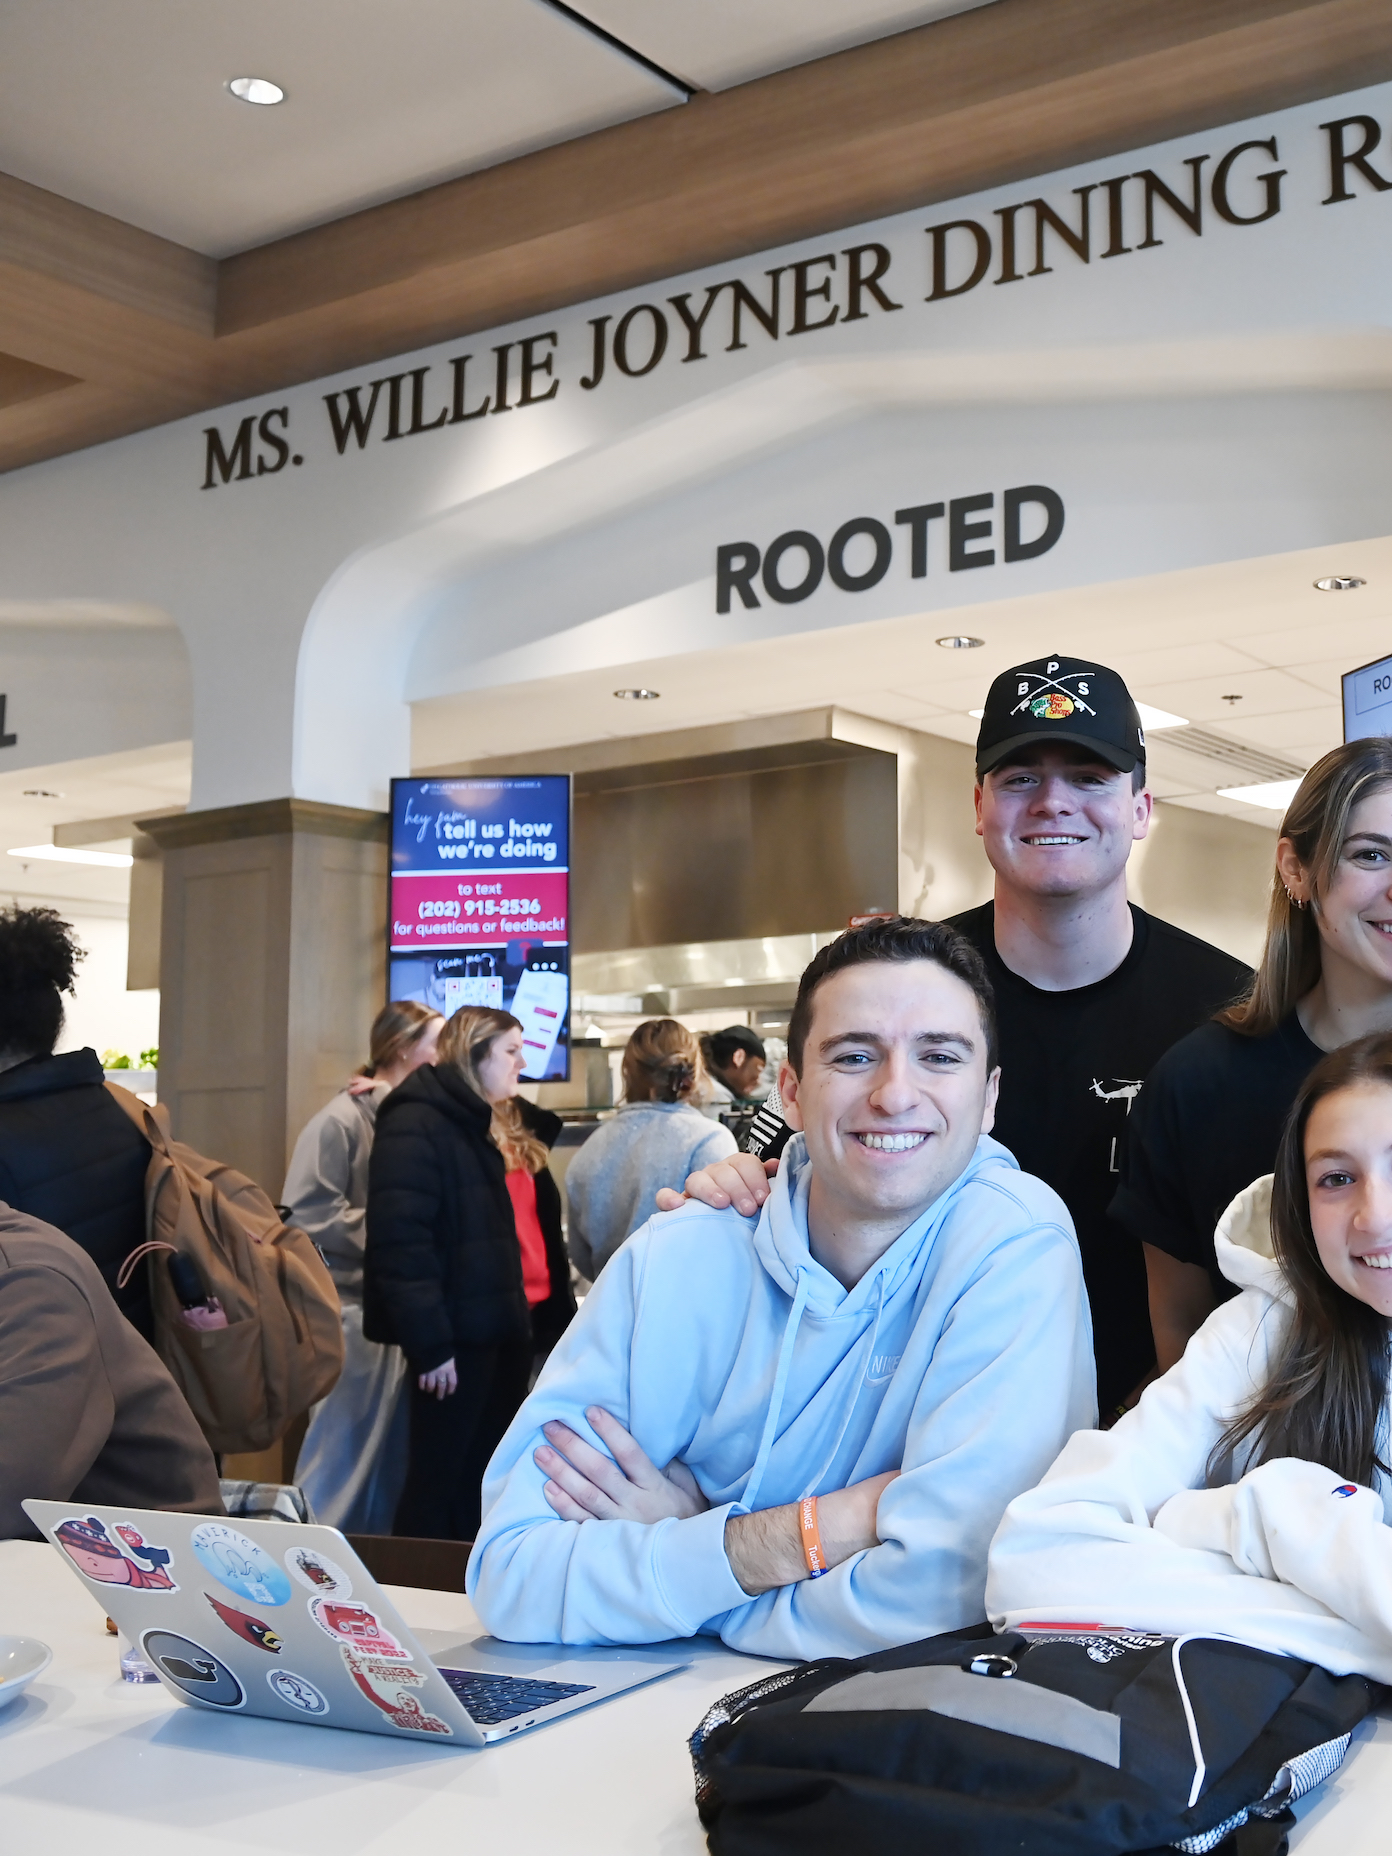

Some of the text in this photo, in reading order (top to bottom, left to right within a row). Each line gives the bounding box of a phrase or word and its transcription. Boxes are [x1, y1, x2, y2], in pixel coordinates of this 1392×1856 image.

[201, 405, 305, 490] MS.
[322, 331, 560, 455] WILLIE
[579, 242, 904, 390] JOYNER
[924, 135, 1288, 303] DINING
[715, 484, 1066, 614] ROOTED
[1047, 661, 1060, 674] P
[1050, 693, 1067, 702] Bass
[404, 797, 432, 843] hey
[443, 818, 553, 840] tell us how
[500, 838, 557, 862] doing
[457, 882, 503, 896] to text
[418, 898, 541, 920] (202) 915-2536
[393, 916, 566, 938] for questions or feedback!
[871, 1354, 902, 1374] NIKE
[803, 1502, 814, 1530] CHANGE
[194, 1526, 261, 1556] MAVERICK
[370, 1667, 413, 1677] JUSTICE
